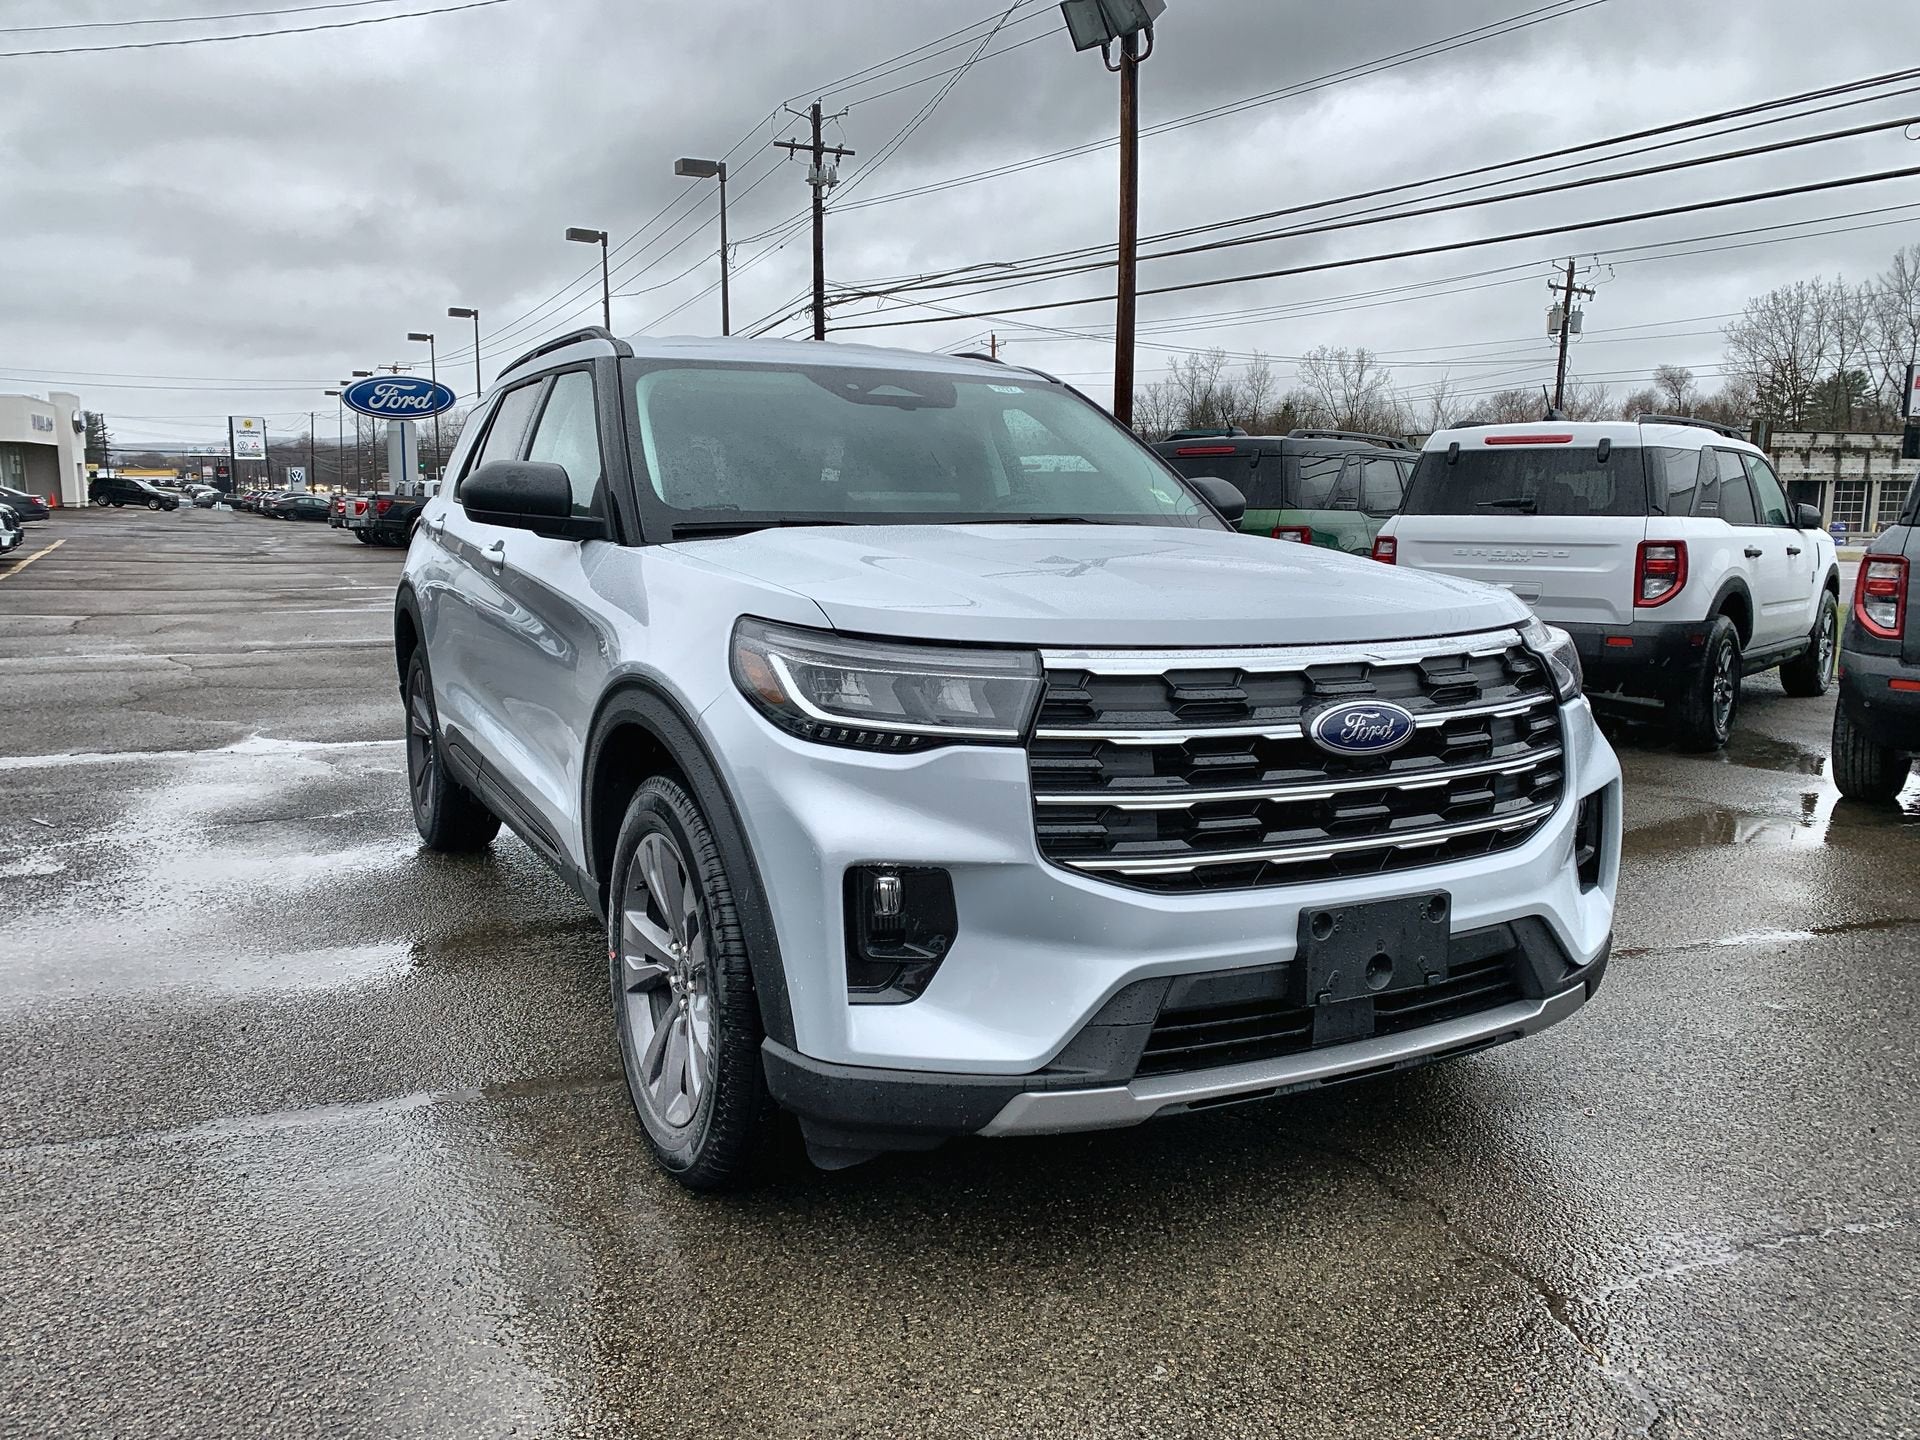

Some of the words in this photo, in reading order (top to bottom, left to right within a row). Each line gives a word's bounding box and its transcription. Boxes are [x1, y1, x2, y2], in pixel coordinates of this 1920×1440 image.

[368, 383, 434, 409] Ford
[1453, 548, 1570, 558] BRONCO
[1341, 712, 1395, 743] Ford
